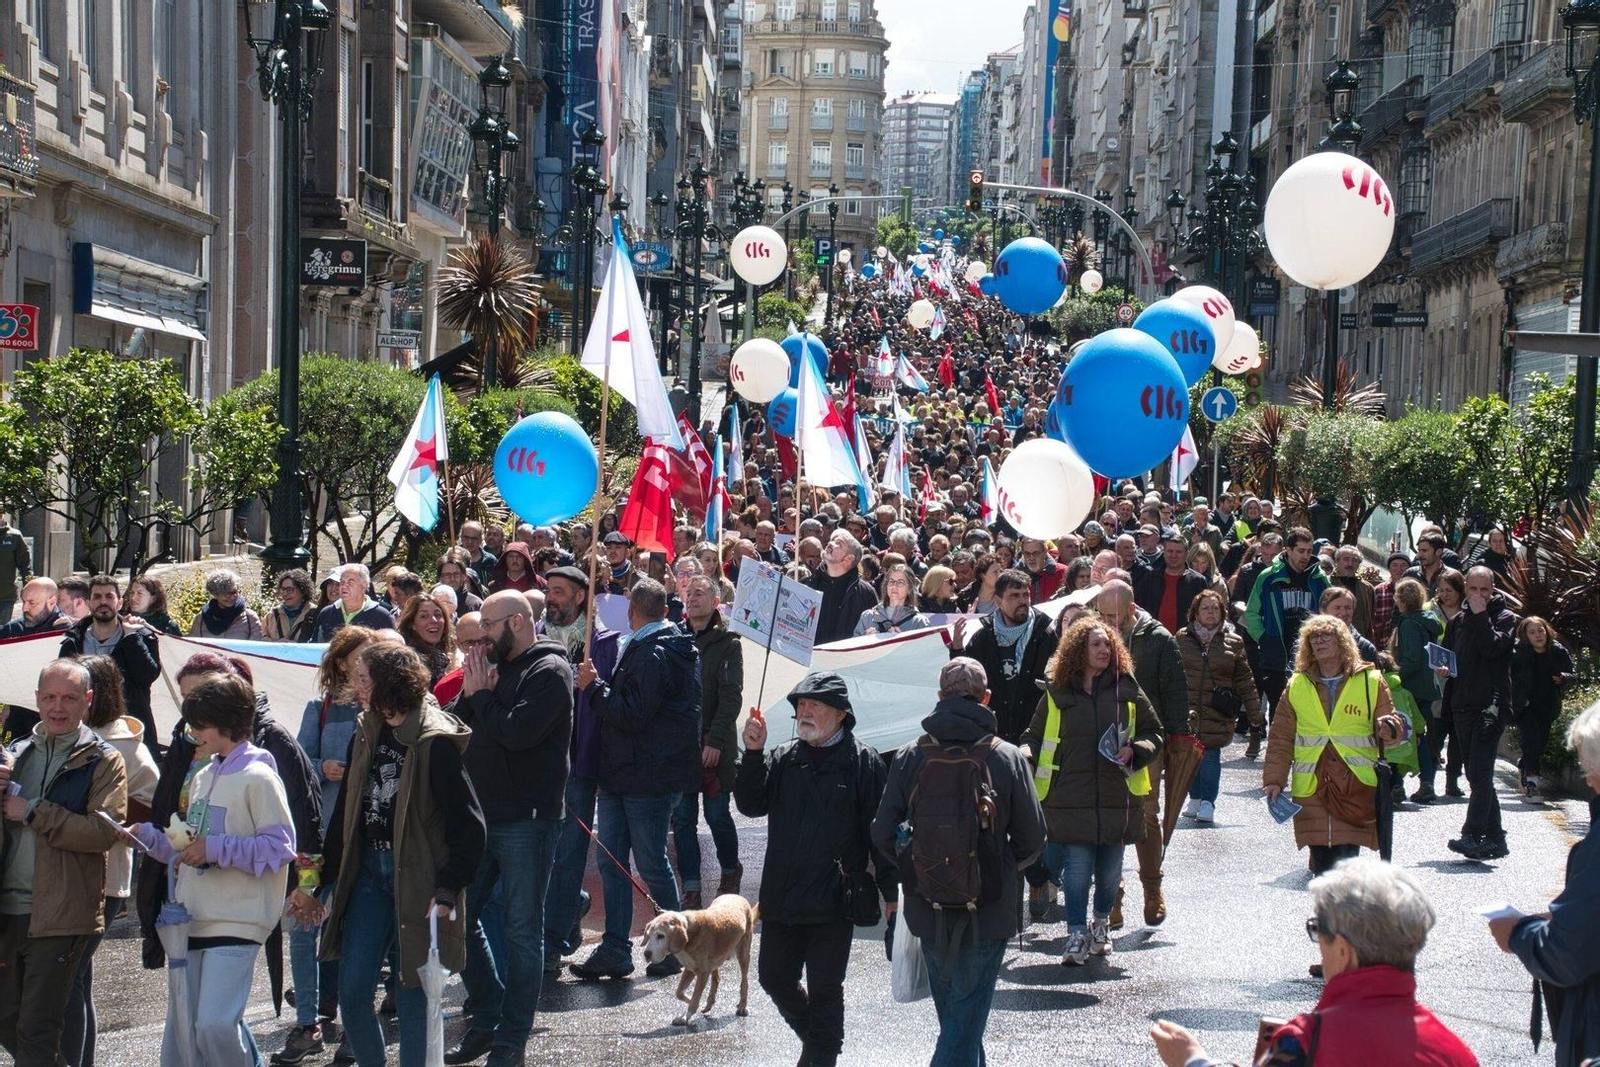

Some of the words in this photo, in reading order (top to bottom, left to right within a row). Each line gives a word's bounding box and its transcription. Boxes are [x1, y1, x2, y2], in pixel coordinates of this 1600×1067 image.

[1342, 165, 1391, 218] CIG
[630, 241, 670, 257] FETERIA
[745, 242, 770, 259] CIG
[819, 240, 831, 255] P
[304, 262, 362, 276] Peregrinus
[1170, 329, 1208, 355] CIG
[1227, 355, 1249, 371] CIG
[731, 363, 745, 383] IG
[1140, 384, 1183, 421] CIG
[508, 446, 546, 477] CIG
[1344, 703, 1362, 717] CIG
